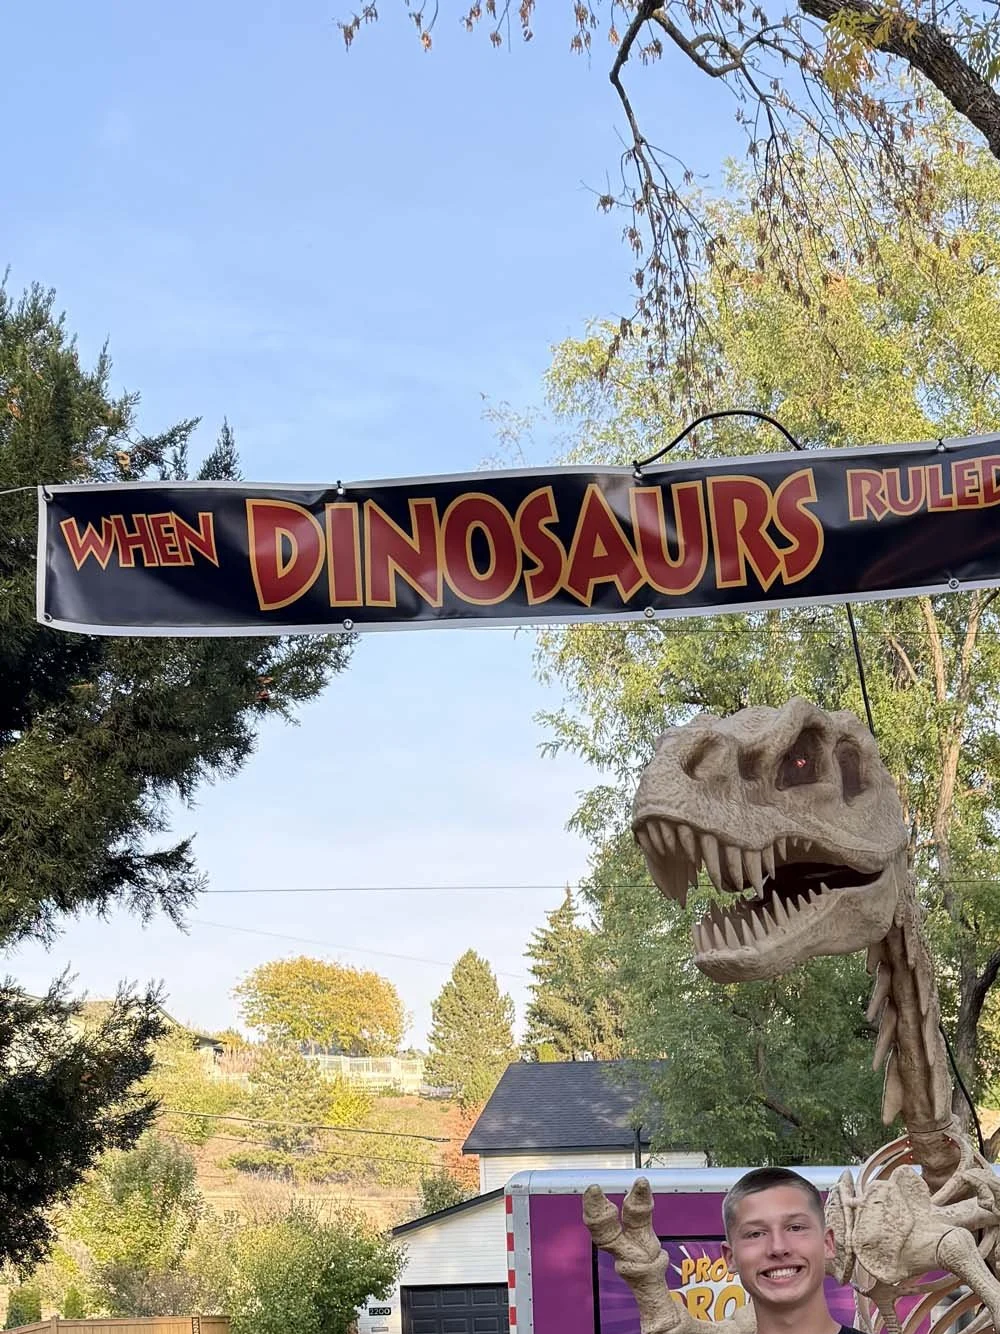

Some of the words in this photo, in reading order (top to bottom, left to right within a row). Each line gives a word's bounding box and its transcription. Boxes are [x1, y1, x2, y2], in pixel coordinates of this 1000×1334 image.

[60, 512, 219, 570] WHEN
[245, 468, 825, 611] DINOSAURS
[681, 1257, 735, 1285] PRO
